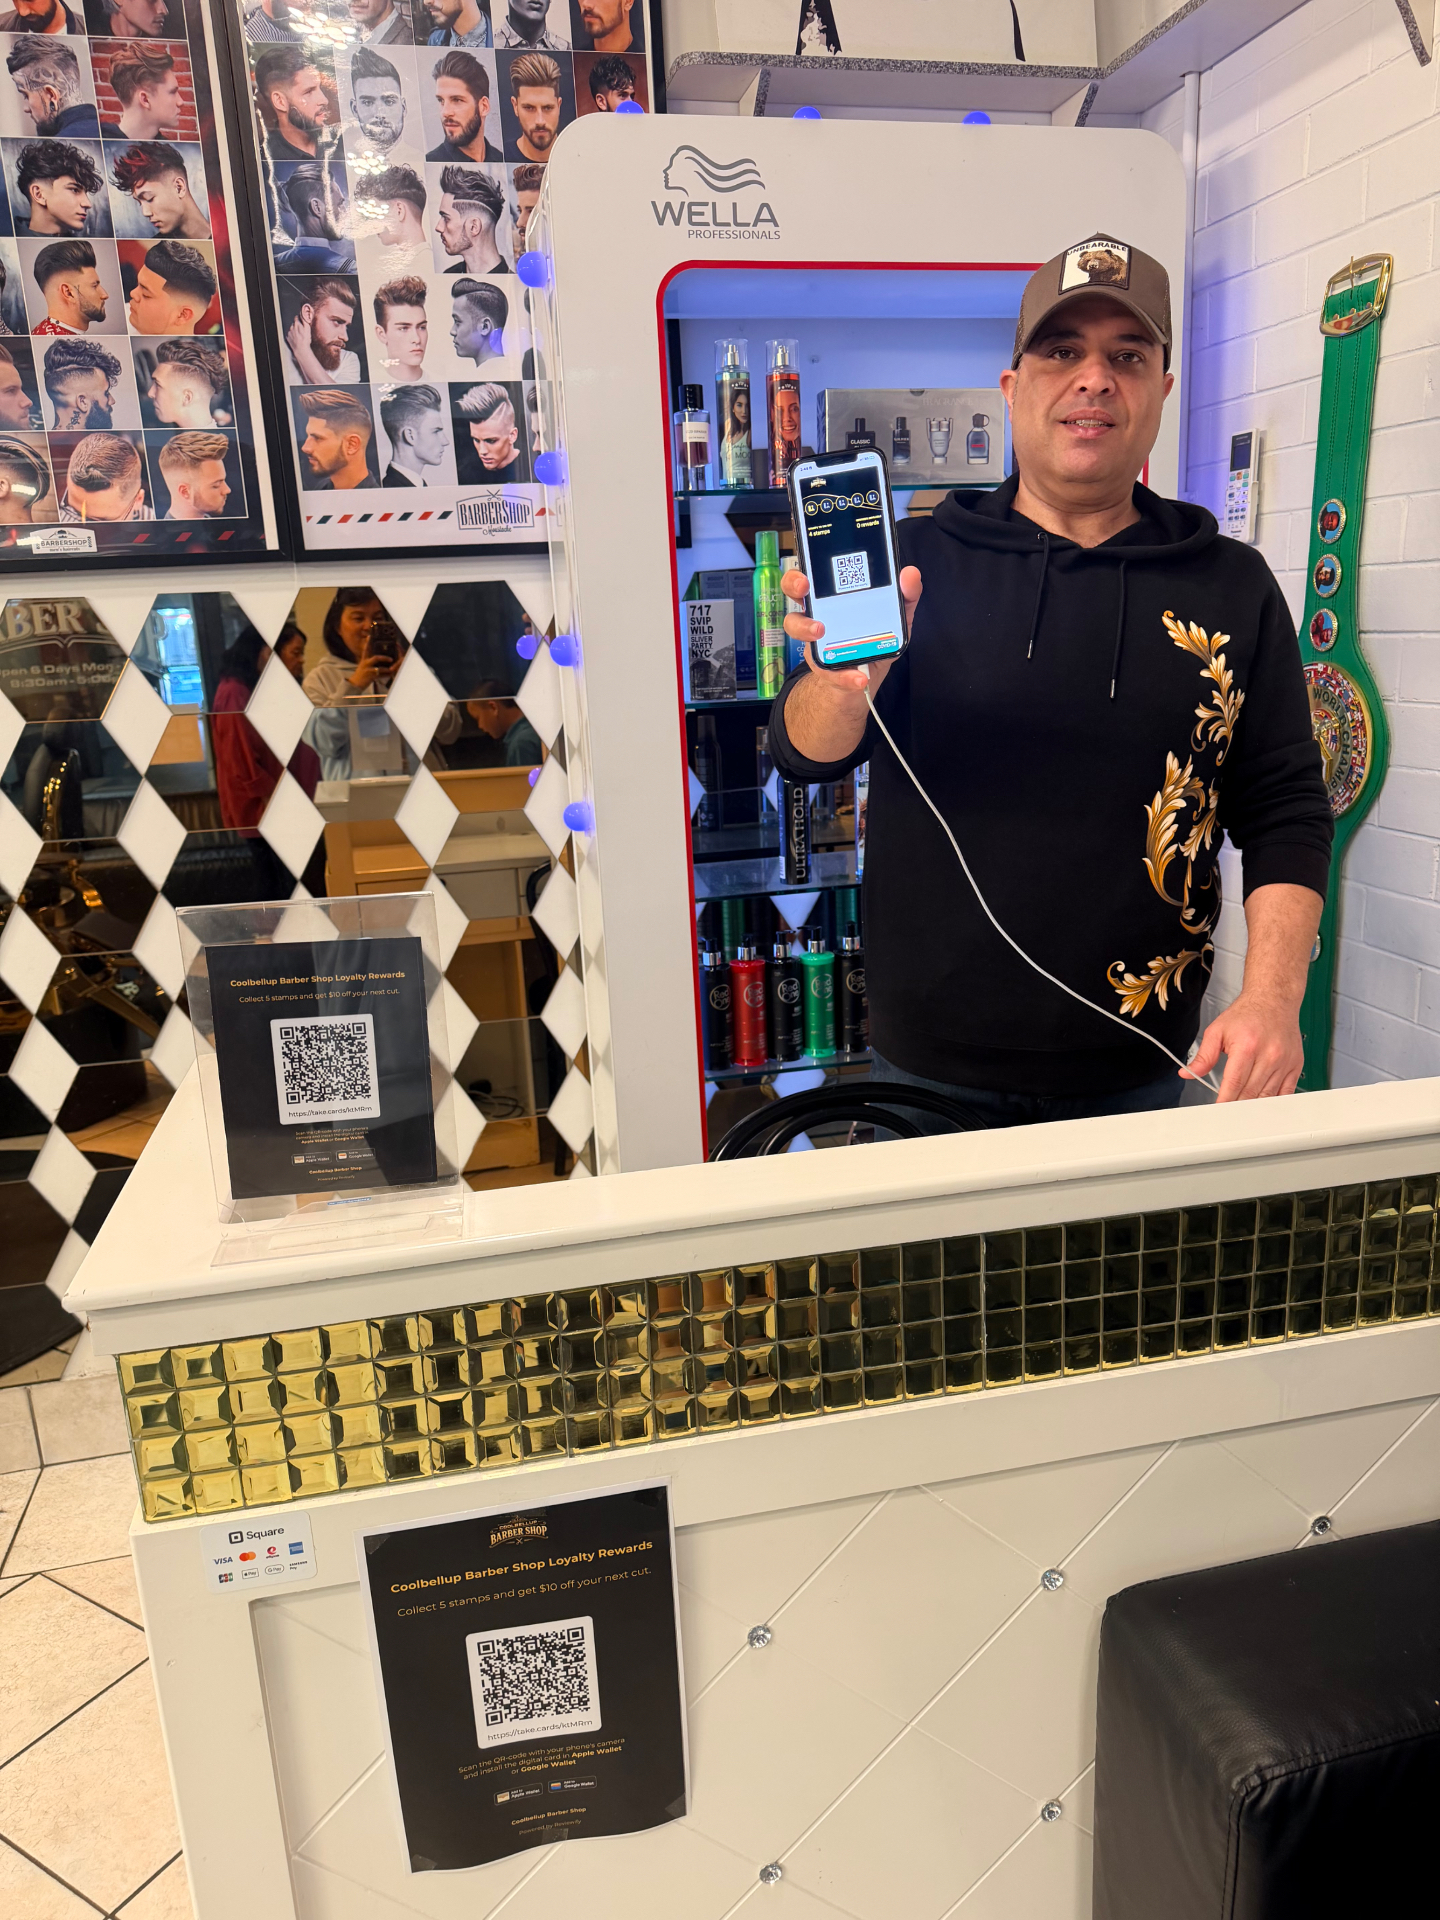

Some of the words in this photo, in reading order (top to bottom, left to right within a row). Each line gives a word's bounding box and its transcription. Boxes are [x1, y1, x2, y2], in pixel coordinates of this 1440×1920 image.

[651, 201, 779, 227] WELLA
[688, 229, 781, 239] PROFESSIONALS
[1067, 242, 1127, 256] UNBEARABLE
[460, 500, 530, 525] BARBERSHOP
[41, 539, 87, 547] BARBERSHOP
[689, 605, 712, 617] 717
[690, 617, 711, 625] SVIP
[690, 626, 714, 635] WILD
[691, 650, 712, 659] NYC
[44, 664, 80, 675] Days
[1312, 687, 1347, 726] WORLD
[1327, 730, 1350, 793] CHAMPI
[793, 787, 805, 831] HOLD
[795, 834, 806, 879] ULTRA
[230, 979, 278, 987] Coolbellup
[279, 976, 309, 984] Barber
[311, 975, 333, 984] Shop
[335, 973, 366, 982] Loyalty
[368, 971, 405, 980] Rewards
[713, 986, 729, 998] Red
[781, 982, 799, 994] Red
[271, 993, 298, 1002] stamps
[299, 992, 313, 1000] and
[314, 992, 327, 1000] get
[328, 990, 341, 998] $10
[351, 990, 369, 998] your
[713, 996, 730, 1008] One
[782, 991, 800, 1001] One
[246, 1527, 285, 1540] Square
[490, 1527, 524, 1546] BARBER
[524, 1525, 548, 1537] SHOP
[213, 1556, 233, 1565] VISA
[390, 1575, 462, 1593] Coolbellup
[465, 1566, 509, 1580] Barber
[512, 1561, 545, 1573] Shop
[548, 1551, 596, 1567] Loyalty
[598, 1541, 653, 1559] Rewards
[397, 1604, 437, 1617] Collect
[439, 1601, 446, 1609] 5
[448, 1594, 491, 1608] stamps
[493, 1588, 515, 1600] and
[517, 1586, 537, 1597] get
[539, 1583, 558, 1593] $10
[560, 1580, 576, 1590] off
[576, 1576, 602, 1589] your
[604, 1571, 629, 1582] next
[631, 1567, 652, 1577] cut.
[487, 1719, 593, 1741] https://take.cards/ktMRm
[458, 1764, 478, 1774] Scan
[478, 1759, 492, 1768] the
[493, 1752, 527, 1764] QR-code
[528, 1748, 546, 1757] with
[546, 1746, 564, 1755] your
[565, 1742, 596, 1753] phone's
[596, 1738, 626, 1748] camera
[463, 1770, 479, 1780] and
[480, 1764, 503, 1776] install
[504, 1761, 517, 1769] the
[518, 1756, 543, 1767] digital
[544, 1753, 561, 1762] card
[571, 1749, 595, 1759] Apple
[596, 1745, 622, 1755] Wallet
[520, 1762, 549, 1773] Google
[550, 1759, 576, 1768] Wallet
[511, 1791, 525, 1799] Apple
[511, 1813, 546, 1826] Coolbellup
[547, 1809, 569, 1818] Barber
[518, 1825, 545, 1836] Powered
